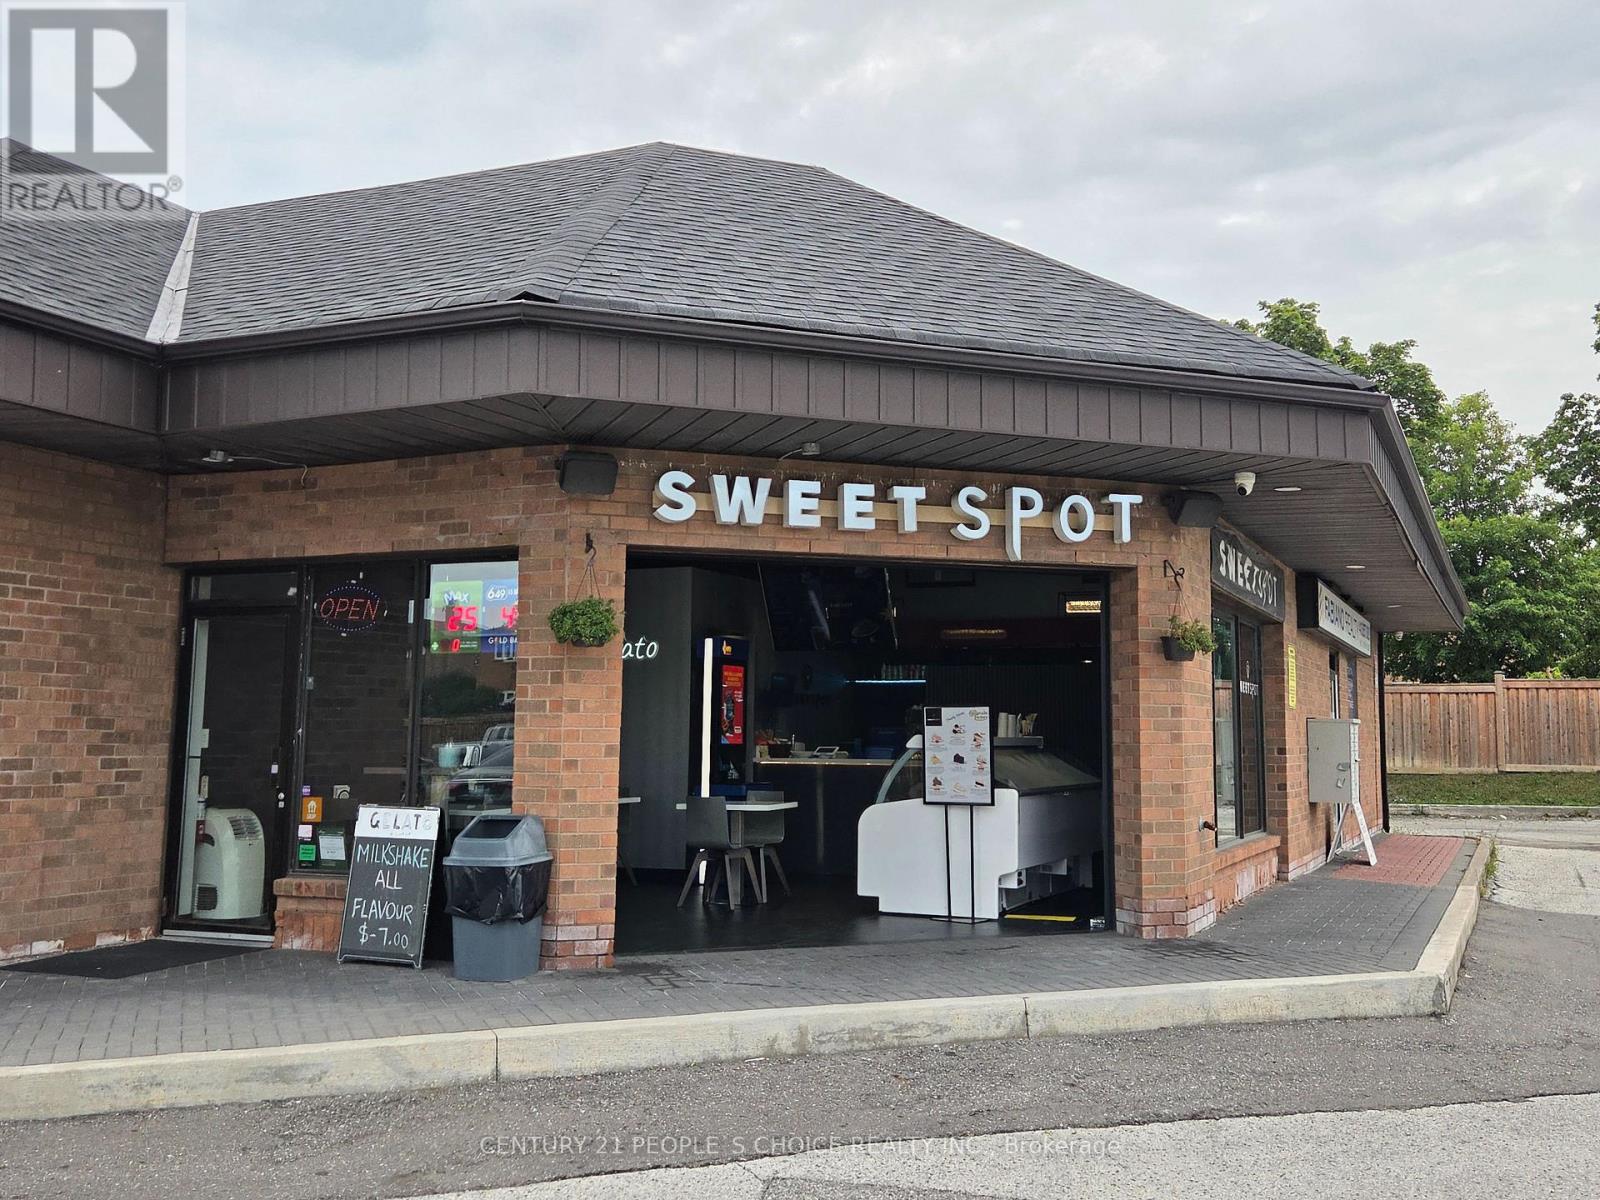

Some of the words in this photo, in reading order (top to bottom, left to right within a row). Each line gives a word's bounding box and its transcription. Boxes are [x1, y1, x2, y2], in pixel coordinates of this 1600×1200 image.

[653, 471, 926, 534] SWEET
[950, 486, 1143, 561] SPOT
[319, 598, 380, 621] OPEN
[447, 605, 479, 632] 25
[356, 842, 430, 869] MILKSHAKE
[374, 869, 403, 890] ALL
[351, 897, 414, 926] FLAVOUR
